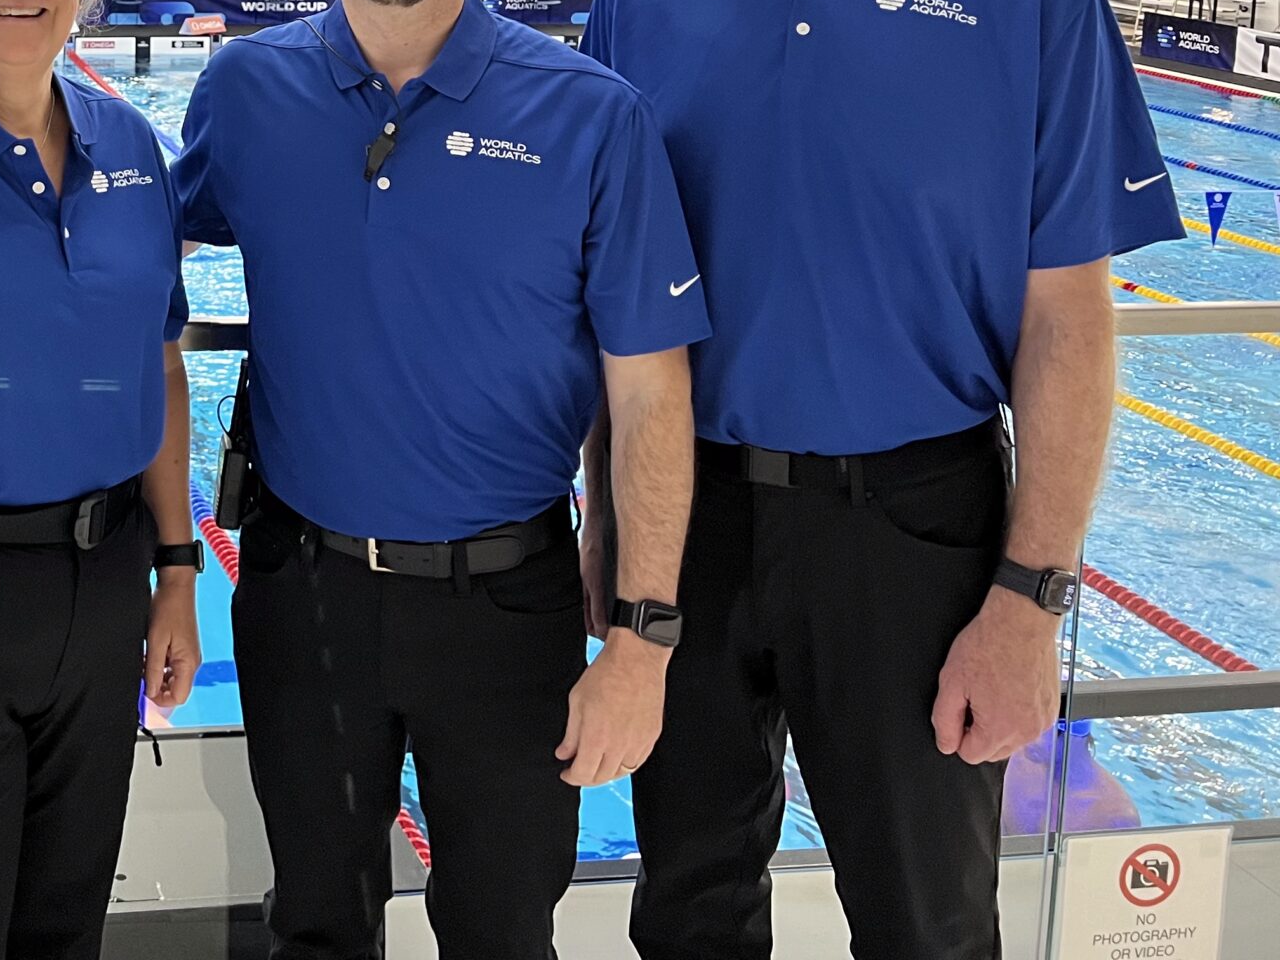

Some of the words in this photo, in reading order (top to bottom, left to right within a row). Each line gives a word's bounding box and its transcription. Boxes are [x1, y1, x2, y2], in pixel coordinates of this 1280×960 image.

[241, 1, 295, 12] WORLD
[296, 1, 328, 12] CUP
[909, 3, 978, 26] AQUATICS
[1178, 31, 1211, 44] WORLD
[1178, 39, 1220, 55] AQUATICS
[480, 137, 527, 152] WORLD
[478, 147, 542, 165] AQUATICS
[109, 168, 140, 180] WORLD
[113, 175, 153, 188] AQUATICS
[1135, 913, 1157, 927] NO
[1092, 926, 1197, 946] PHOTOGRAPHY
[1110, 947, 1131, 960] OR
[1134, 944, 1175, 959] VIDEO
